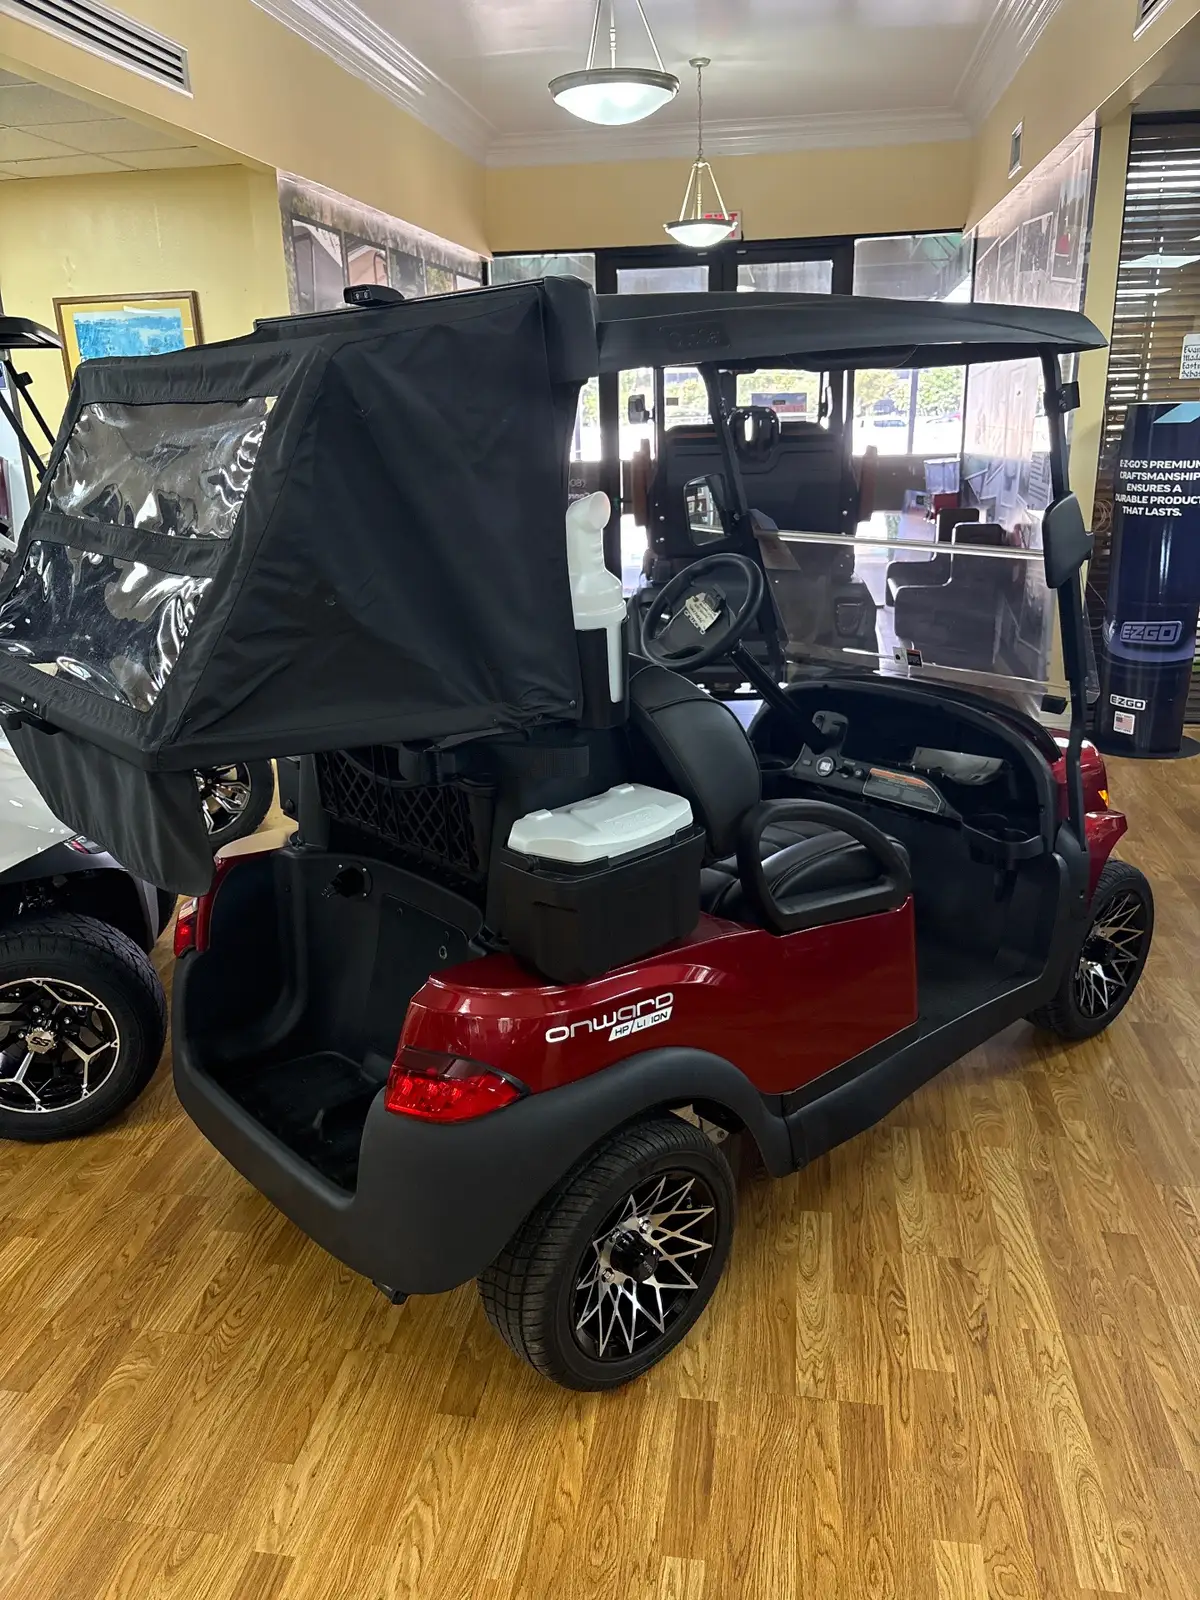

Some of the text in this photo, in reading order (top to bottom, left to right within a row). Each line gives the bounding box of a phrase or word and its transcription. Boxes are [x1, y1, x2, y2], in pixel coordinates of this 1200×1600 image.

[1120, 471, 1200, 481] CRAFTSMANSHIP
[1126, 483, 1182, 493] ENSURES A
[1115, 493, 1148, 504] DURABLE
[1122, 506, 1182, 517] THAT LASTS.
